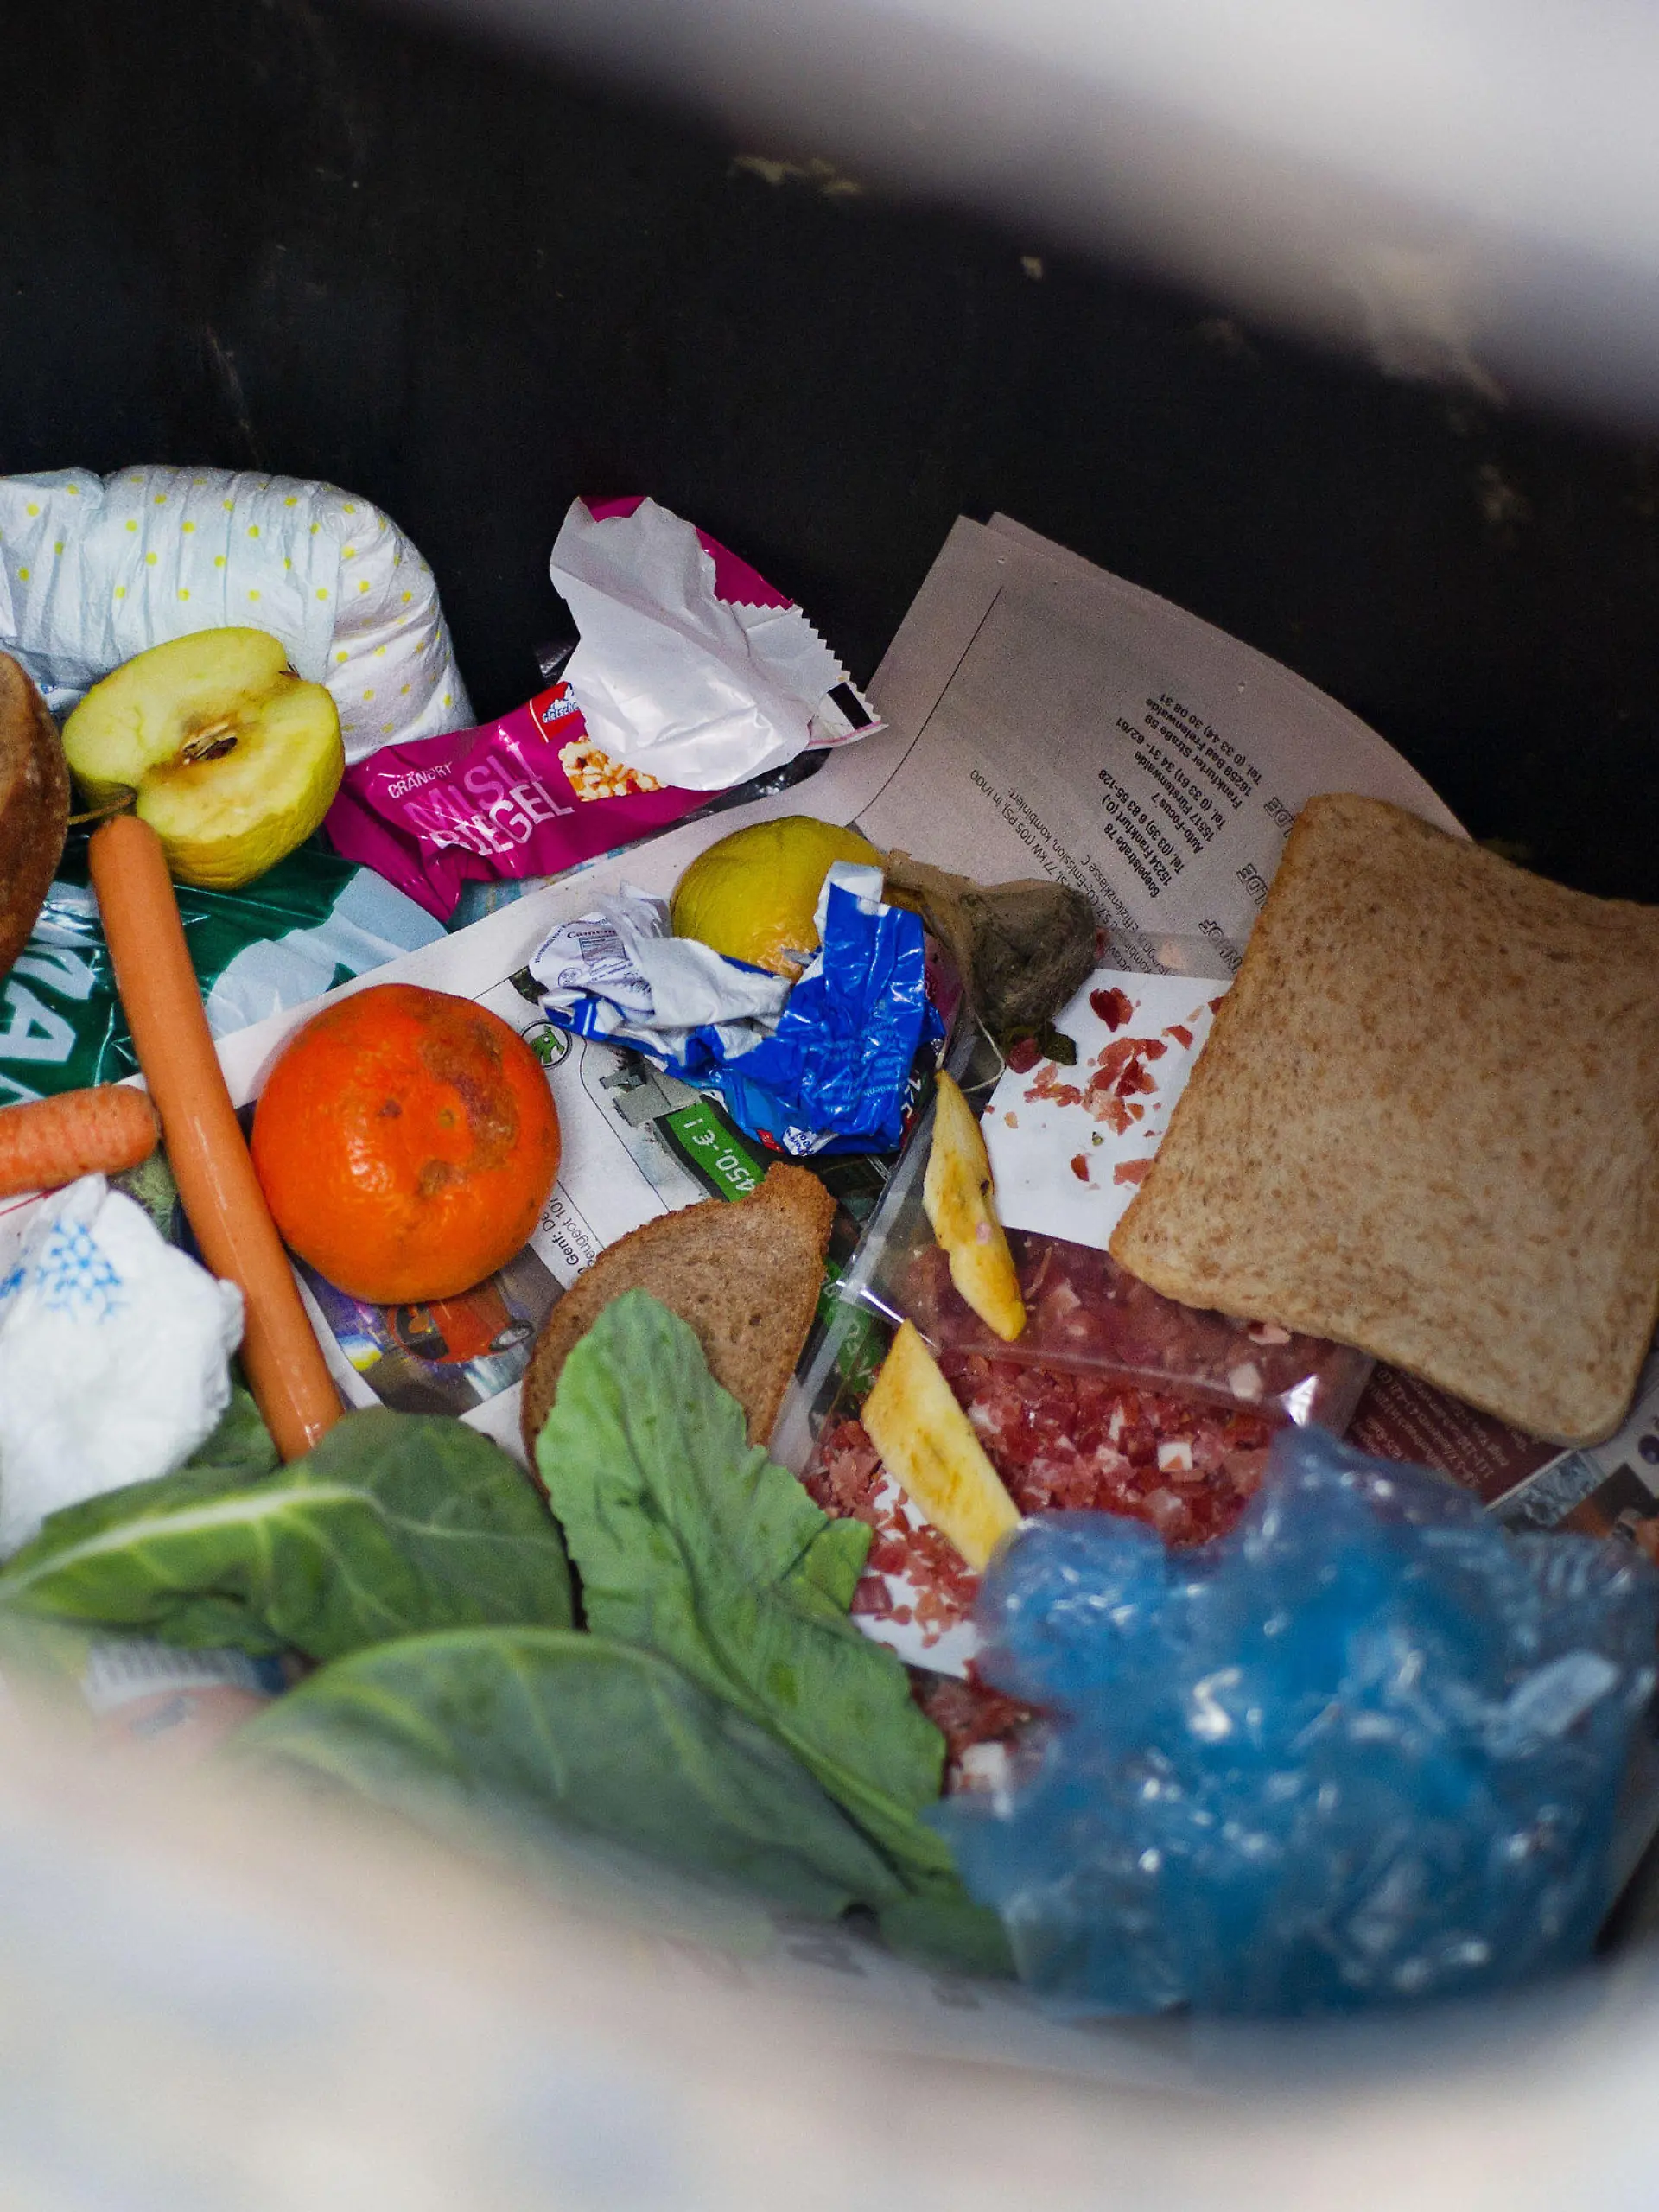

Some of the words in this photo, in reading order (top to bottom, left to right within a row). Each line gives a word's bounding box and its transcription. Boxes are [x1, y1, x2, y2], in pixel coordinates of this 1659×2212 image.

[1159, 693, 1173, 705] 31
[1143, 713, 1160, 729] 59
[1186, 713, 1204, 728] 30
[1158, 724, 1194, 758] Straße
[1201, 724, 1221, 744] 44)
[1202, 747, 1225, 768] Bad
[1216, 741, 1234, 757] 33
[1159, 755, 1175, 772] 34
[1230, 752, 1247, 767] (0
[1133, 749, 1193, 815] Fürstenwalde
[1170, 767, 1191, 788] 61)
[1190, 753, 1243, 810] Frankfurter
[1221, 764, 1253, 798] 16259
[1240, 764, 1263, 785] Tel.
[1096, 768, 1130, 804] 55-128
[1150, 791, 1161, 801] 7
[1185, 785, 1202, 801] 33
[990, 792, 1003, 806] in
[1124, 799, 1141, 816] 83
[1198, 797, 1212, 811] (0
[1135, 813, 1148, 824] 6
[1156, 798, 1204, 854] Auto-Focus
[1188, 811, 1216, 842] 15517
[1206, 808, 1226, 828] Tel.
[1014, 821, 1036, 846] (105
[1102, 822, 1118, 838] 78
[1113, 810, 1154, 858] Frankfurt
[1142, 819, 1162, 841] 35)
[1030, 842, 1048, 862] kW
[1154, 836, 1175, 856] (03
[1043, 859, 1057, 874] 77
[1113, 835, 1160, 898] Goepelstraße
[1147, 855, 1174, 886] 15234
[1166, 853, 1186, 874] Tel.
[550, 1231, 579, 1264] Genf:
